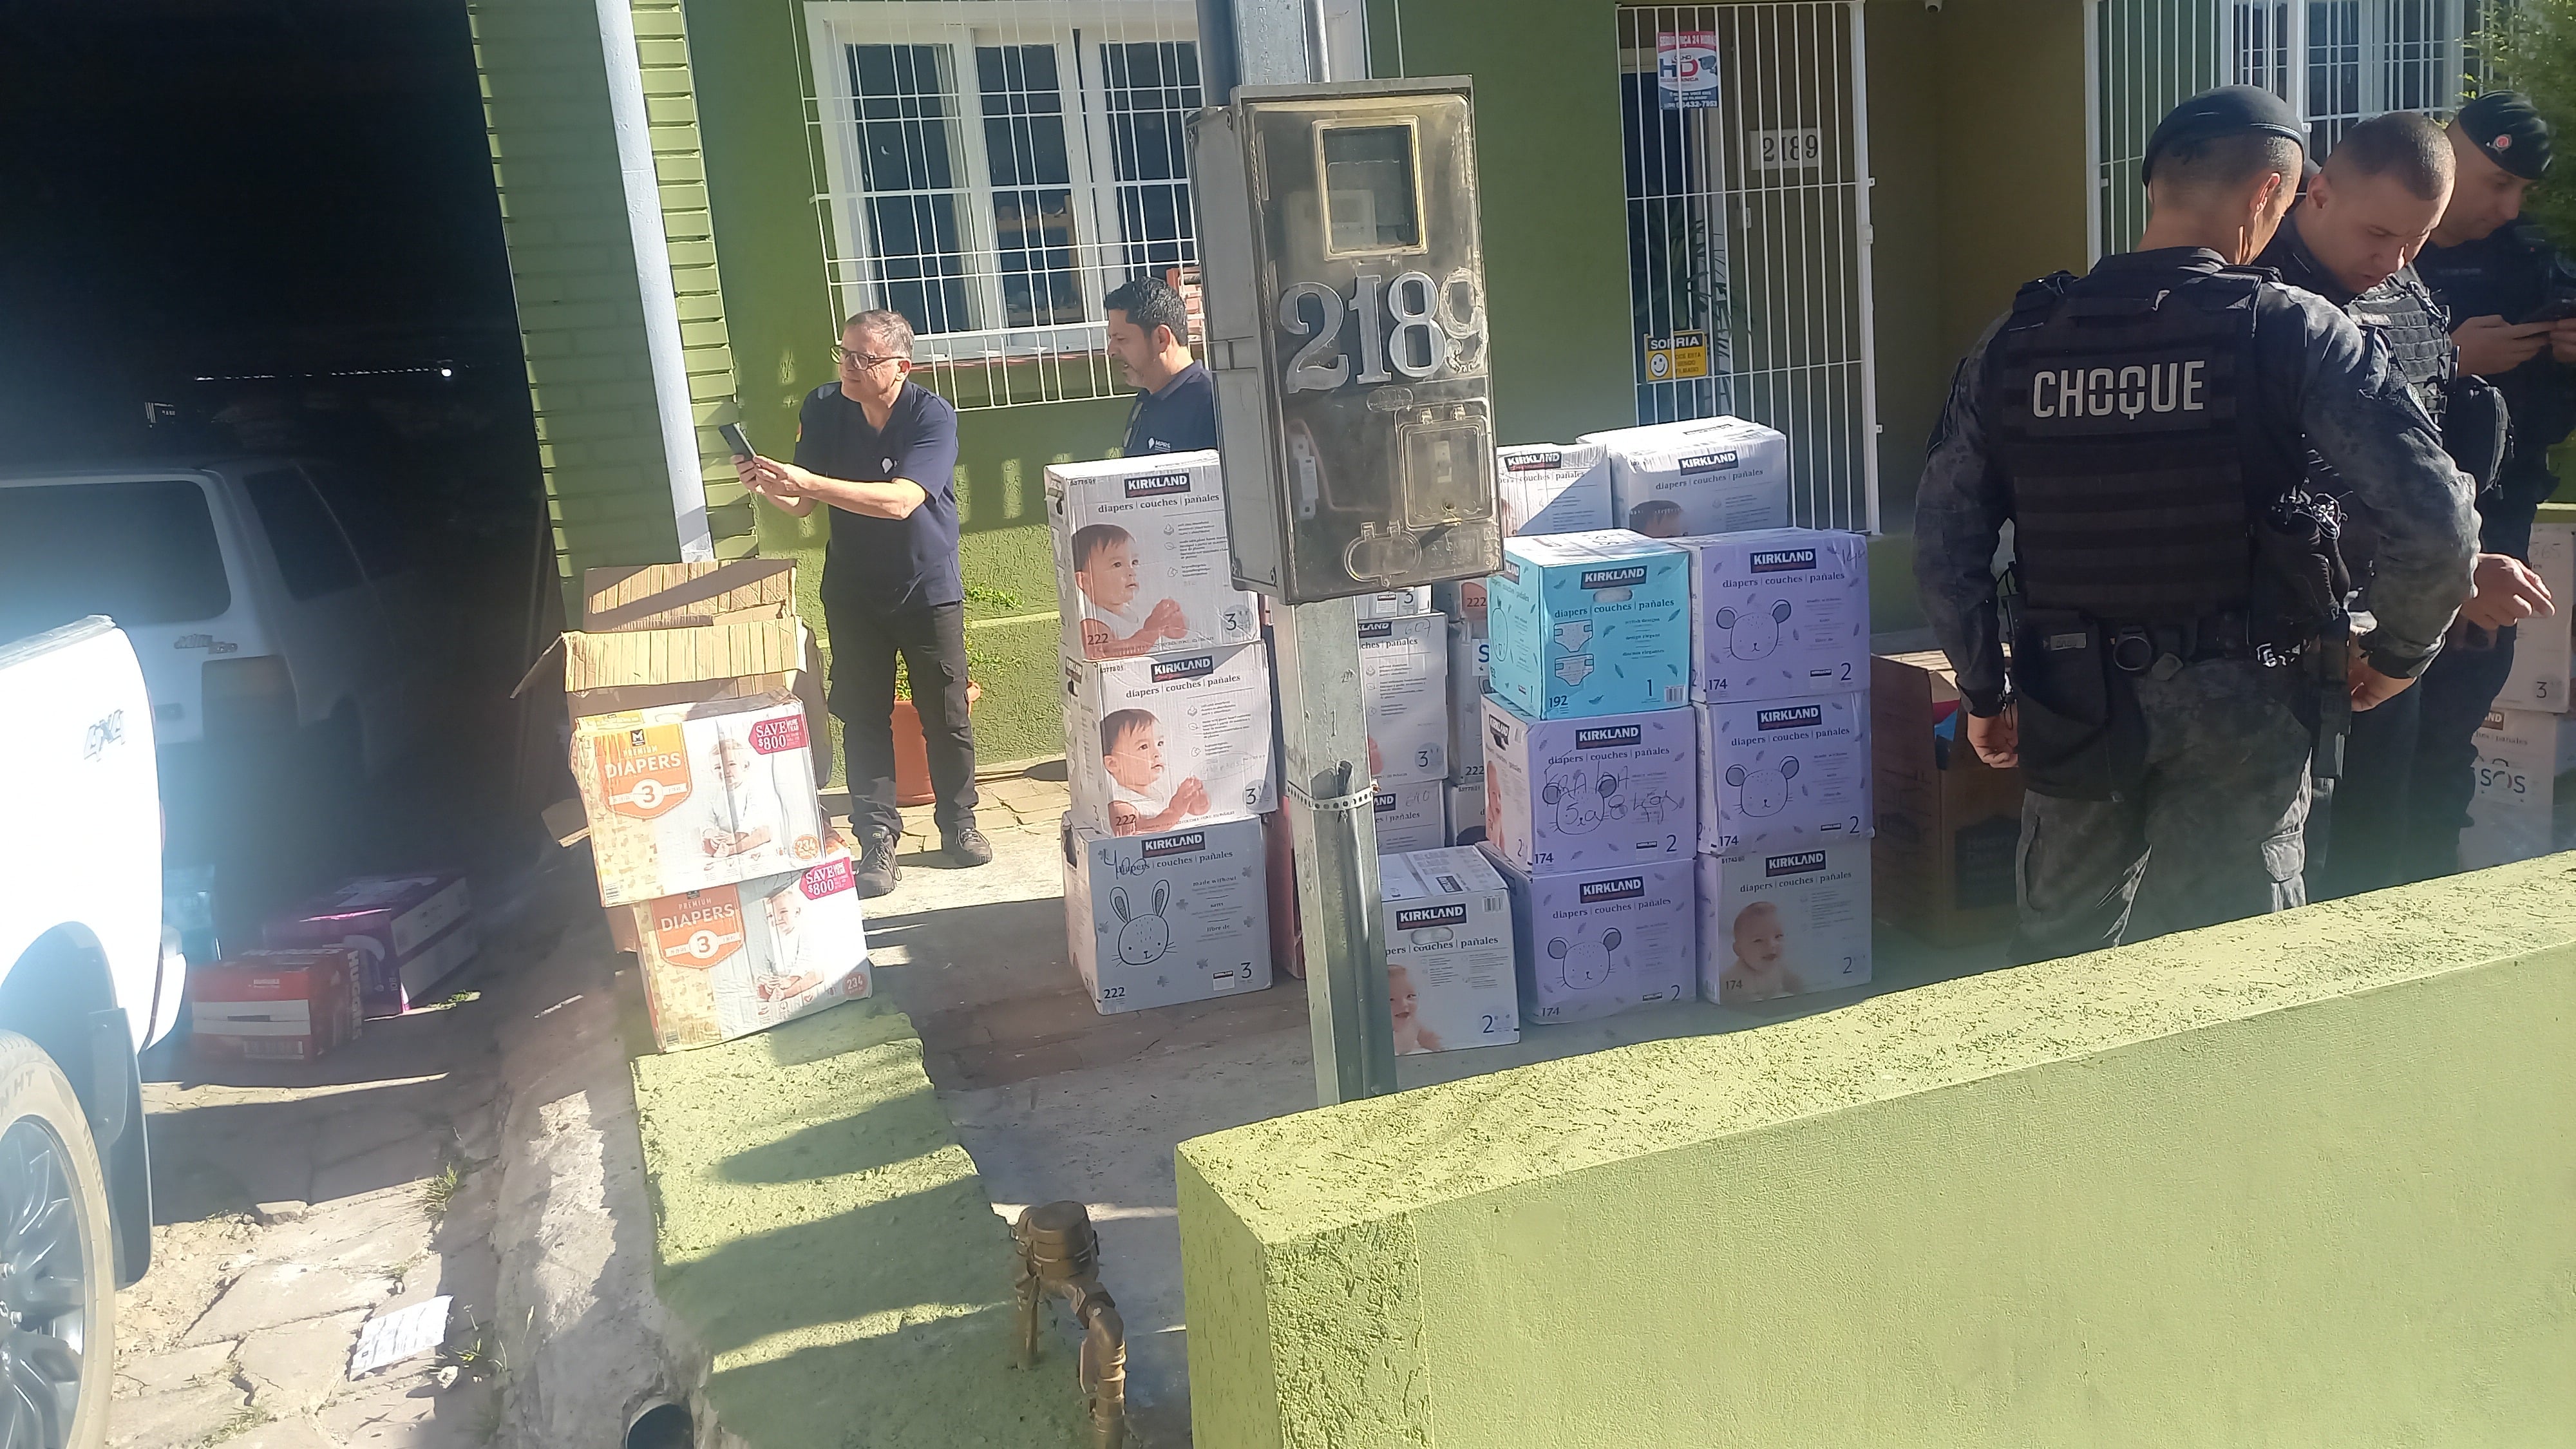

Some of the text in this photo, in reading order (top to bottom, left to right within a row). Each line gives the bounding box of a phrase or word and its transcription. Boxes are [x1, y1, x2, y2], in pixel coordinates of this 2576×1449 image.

[1660, 58, 1698, 77] HD
[1763, 135, 1819, 162] 2189
[1279, 267, 1488, 394] 2189
[2033, 360, 2205, 419] CHOQUE
[1508, 453, 1560, 466] KIRKLAND
[1681, 452, 1737, 469] KIRKLAND
[1128, 475, 1187, 490] KIRKLAND
[1556, 471, 1585, 481] pañales
[1656, 468, 1763, 490] diapers couches pañales
[1098, 494, 1220, 513] diapers couches pañales
[1754, 551, 1814, 565] KIRKLAND
[1585, 568, 1645, 583] KIRKLAND
[1723, 572, 1845, 589] diapers couches pañales
[1404, 592, 1414, 603] 3
[1467, 597, 1487, 607] 222
[1555, 598, 1674, 618] diapers couches pañales
[1225, 612, 1237, 630] 3
[1087, 633, 1108, 645] 222
[1154, 658, 1211, 676] KIRKLAND
[1841, 663, 1852, 681] 2
[1126, 675, 1240, 698] diapers couches pañales
[1646, 679, 1653, 696] 1
[1709, 679, 1728, 690] 174
[2536, 681, 2547, 699] 3
[1549, 695, 1568, 708] 192
[1761, 707, 1819, 723] KIRKLAND
[755, 720, 787, 737] SAVE
[1579, 726, 1639, 742] KIRKLAND
[758, 735, 786, 750] $800
[1731, 736, 1766, 746] diapers
[1772, 732, 1809, 742] couches
[623, 745, 658, 757] PREMIUM
[1418, 750, 1428, 767] 3
[1548, 747, 1670, 765] diapers couches pañales
[605, 752, 681, 779] DIAPERS
[1466, 766, 1484, 776] 222
[642, 785, 655, 802] 3
[1246, 788, 1256, 804] 3
[1115, 814, 1136, 826] 222
[1849, 816, 1859, 833] 2
[1145, 834, 1203, 851] KIRKLAND
[1666, 835, 1677, 852] 2
[1719, 835, 1739, 847] 174
[1157, 857, 1192, 867] couches
[1199, 851, 1233, 863] pañales
[1535, 853, 1554, 864] 174
[1769, 853, 1824, 869] KIRKLAND
[805, 865, 833, 884] SAVE
[1740, 871, 1852, 893] diapers couches pañales
[808, 878, 835, 895] $800
[1584, 880, 1642, 895] KIRKLAND
[678, 898, 712, 910] PREMIUM
[1553, 898, 1671, 919] diapers couches pañales
[661, 904, 735, 932] DIAPERS
[1400, 906, 1464, 922] KIRKLAND
[697, 936, 711, 952] 3
[1385, 936, 1499, 958] pers couches pañales
[1240, 961, 1252, 979] 3
[1842, 957, 1852, 974] 2
[847, 976, 863, 990] 234
[1726, 980, 1743, 990] 174
[1104, 987, 1125, 999] 222
[1542, 1007, 1560, 1016] 174
[1482, 1015, 1495, 1034] 2
